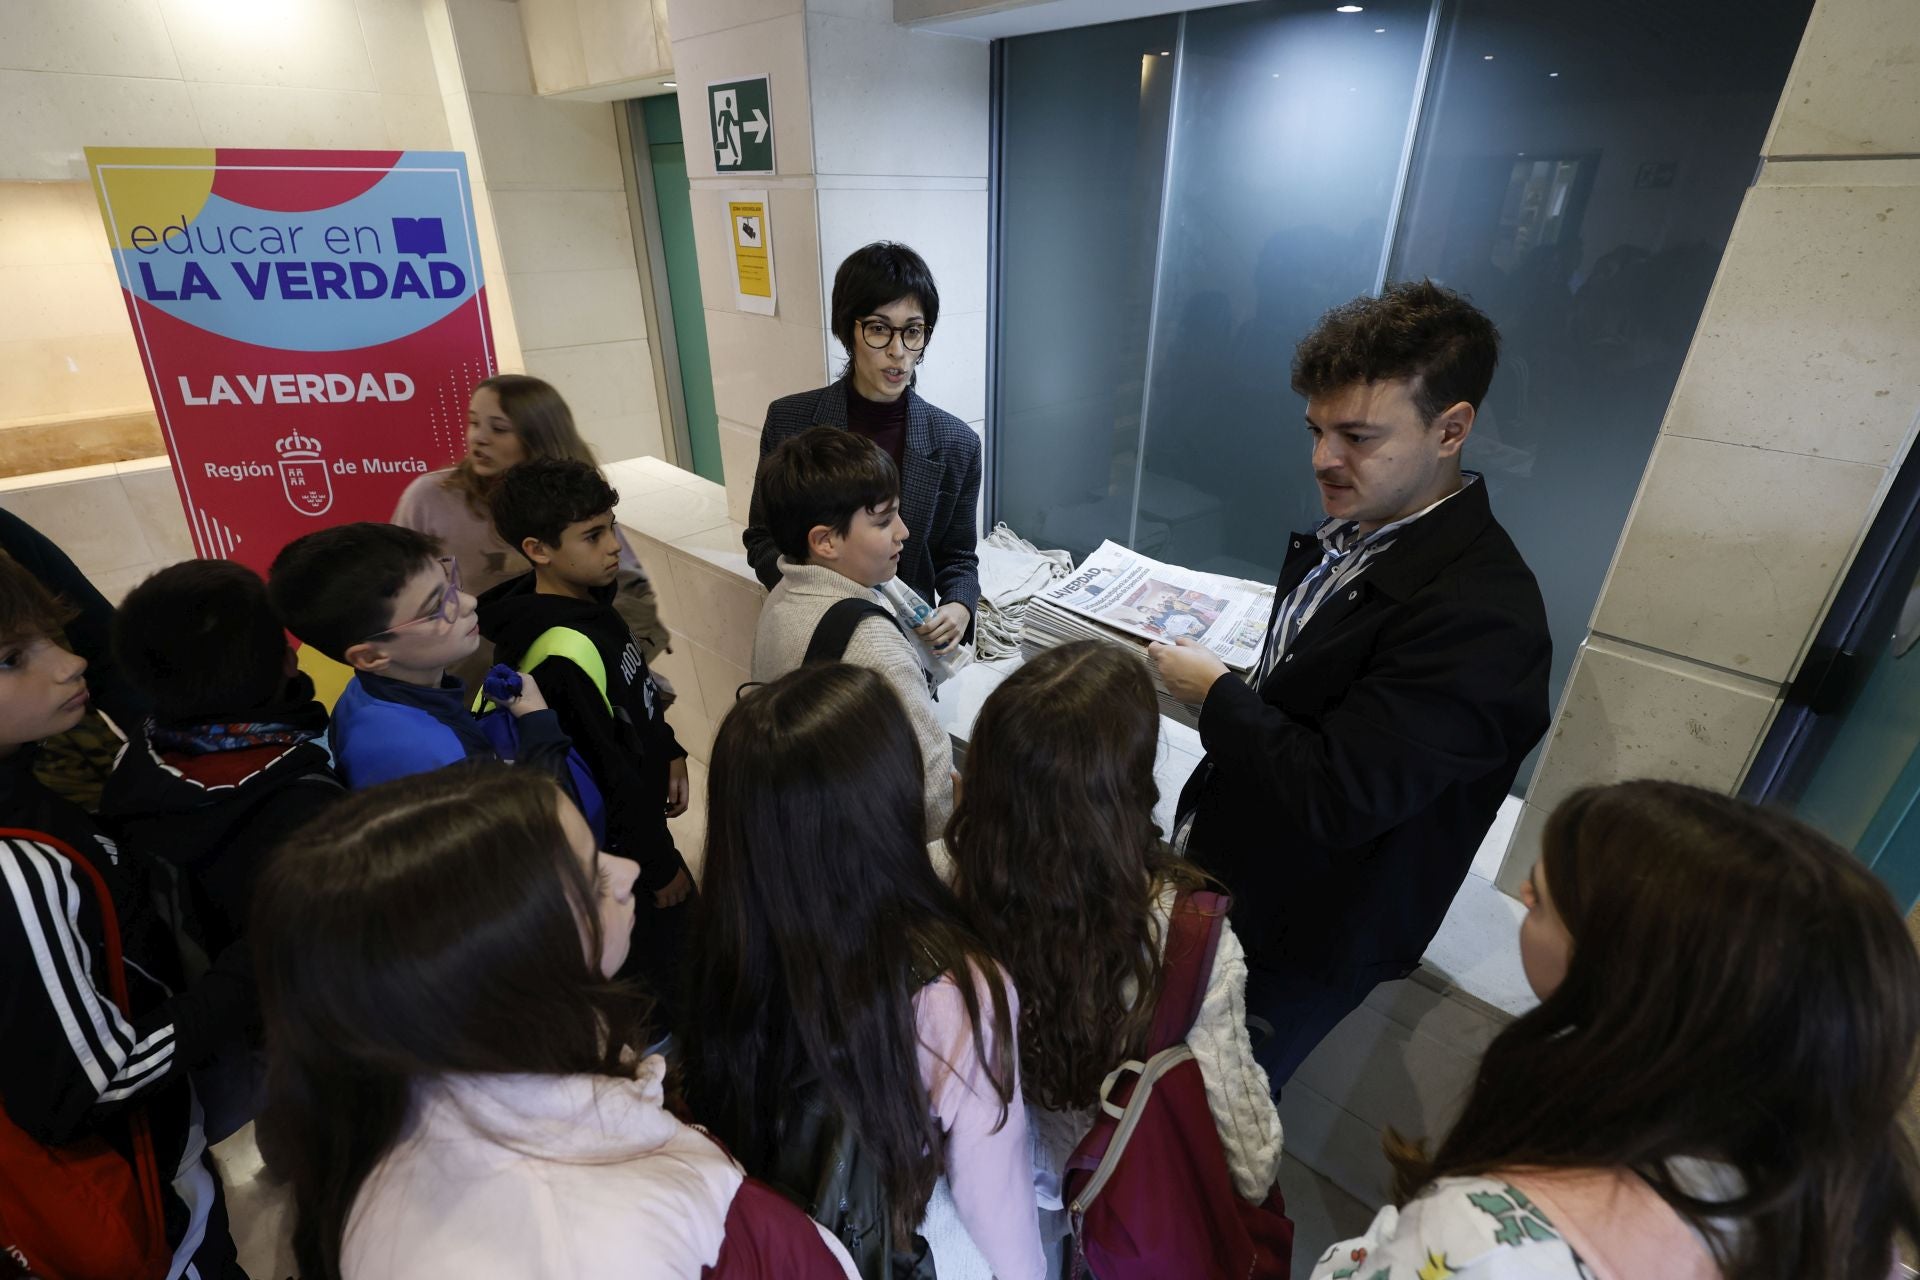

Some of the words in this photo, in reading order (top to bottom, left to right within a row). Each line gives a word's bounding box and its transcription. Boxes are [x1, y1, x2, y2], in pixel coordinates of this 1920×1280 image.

[131, 215, 303, 254] educar
[324, 226, 381, 254] en
[138, 262, 222, 301] LA
[231, 261, 466, 301] VERDAD
[204, 460, 274, 481] Región
[333, 458, 357, 475] de
[362, 456, 428, 474] Murcia
